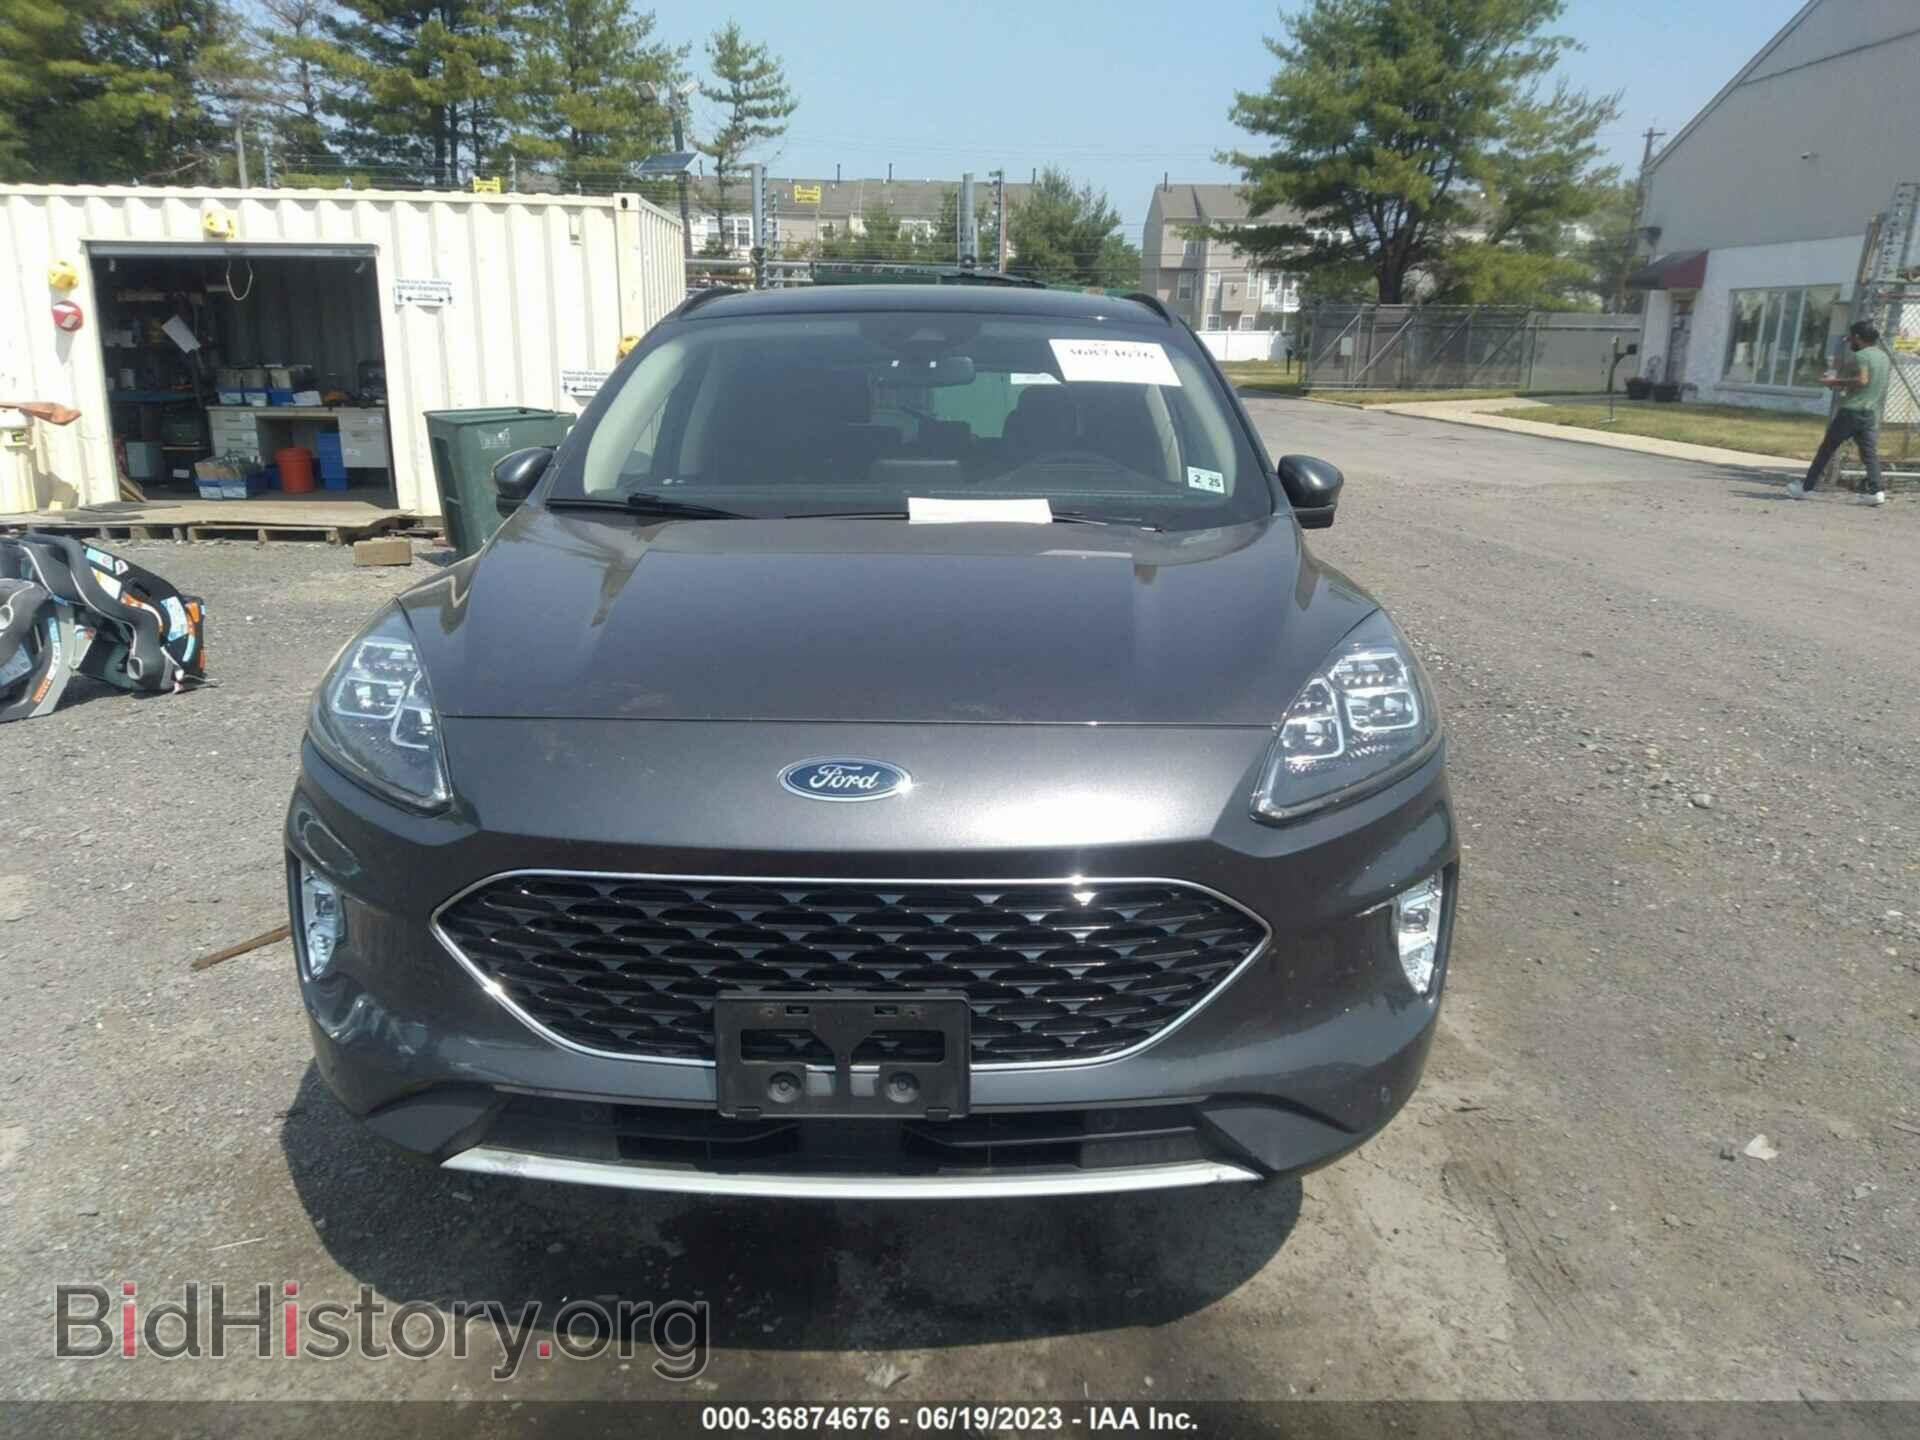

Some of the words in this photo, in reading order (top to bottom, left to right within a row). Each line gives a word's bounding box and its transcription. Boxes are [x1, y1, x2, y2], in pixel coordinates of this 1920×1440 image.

[1193, 474, 1202, 484] 2
[1208, 476, 1221, 488] 25
[809, 764, 881, 789] Ford
